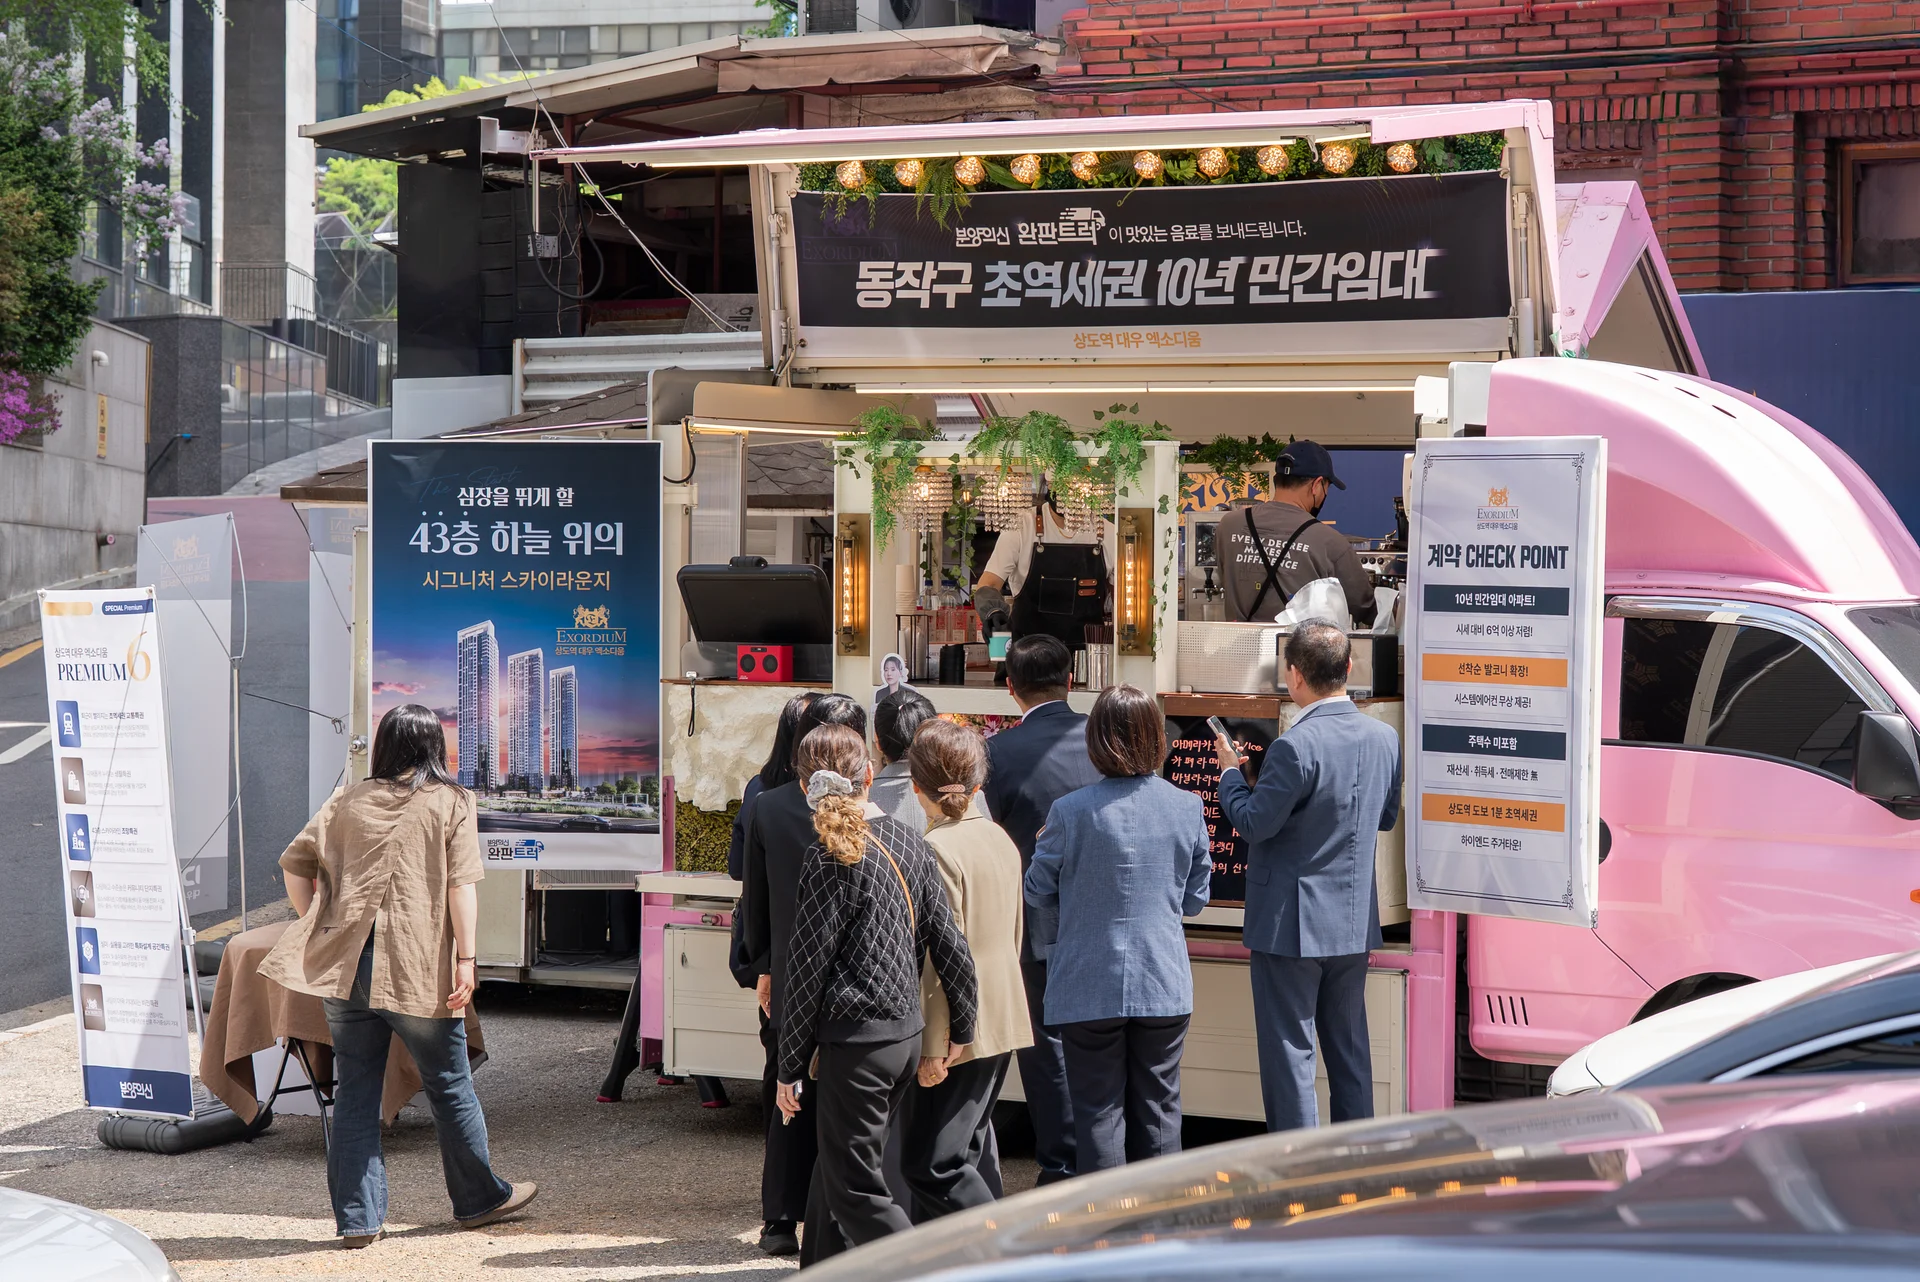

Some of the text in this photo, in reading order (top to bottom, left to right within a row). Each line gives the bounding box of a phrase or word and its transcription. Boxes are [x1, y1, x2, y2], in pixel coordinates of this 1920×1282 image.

[955, 226, 1011, 248] 분양의신
[1109, 226, 1122, 244] 이
[1126, 224, 1167, 243] 맛있는
[1171, 222, 1213, 242] 음료를
[1216, 220, 1307, 240] 보내드립니다.
[856, 248, 1444, 309] 동작구 초역세권 10년 민간임대
[1074, 331, 1201, 349] 상도역 대우 엑소디움
[457, 487, 574, 507] 심장을 뛰게 할
[1477, 508, 1519, 519] EXORDIUM
[1477, 522, 1518, 531] 상도역 대우 엑소디움
[409, 521, 623, 556] 43층 하늘 위의
[1428, 544, 1569, 570] 계약 CHECK POINT
[423, 570, 611, 591] 시그니처 스카이라운지
[1455, 593, 1535, 607] 10년 민간임대 아파트!
[556, 630, 627, 644] EXORDIUM
[1456, 624, 1533, 638] 시세 대비 6억 이상 저렴!
[55, 647, 71, 659] 상도역
[71, 647, 84, 658] 대우
[555, 646, 625, 656] 상도역 대우 엑소디움
[57, 663, 127, 681] PREMIUM
[1458, 663, 1529, 678] 선착순 발코니 확장!
[1454, 693, 1532, 709] 시스템에어컨 무상 제공!
[1468, 735, 1518, 751] 주택수 미포함
[1446, 764, 1470, 777] 재산세
[1474, 765, 1495, 779] 취득세
[1500, 766, 1529, 781] 전매제한
[1448, 803, 1538, 822] 상도역 도보 1분 초역세권
[1461, 834, 1522, 851] 하이엔드 주거타운!
[119, 1081, 154, 1100] 분양의신
